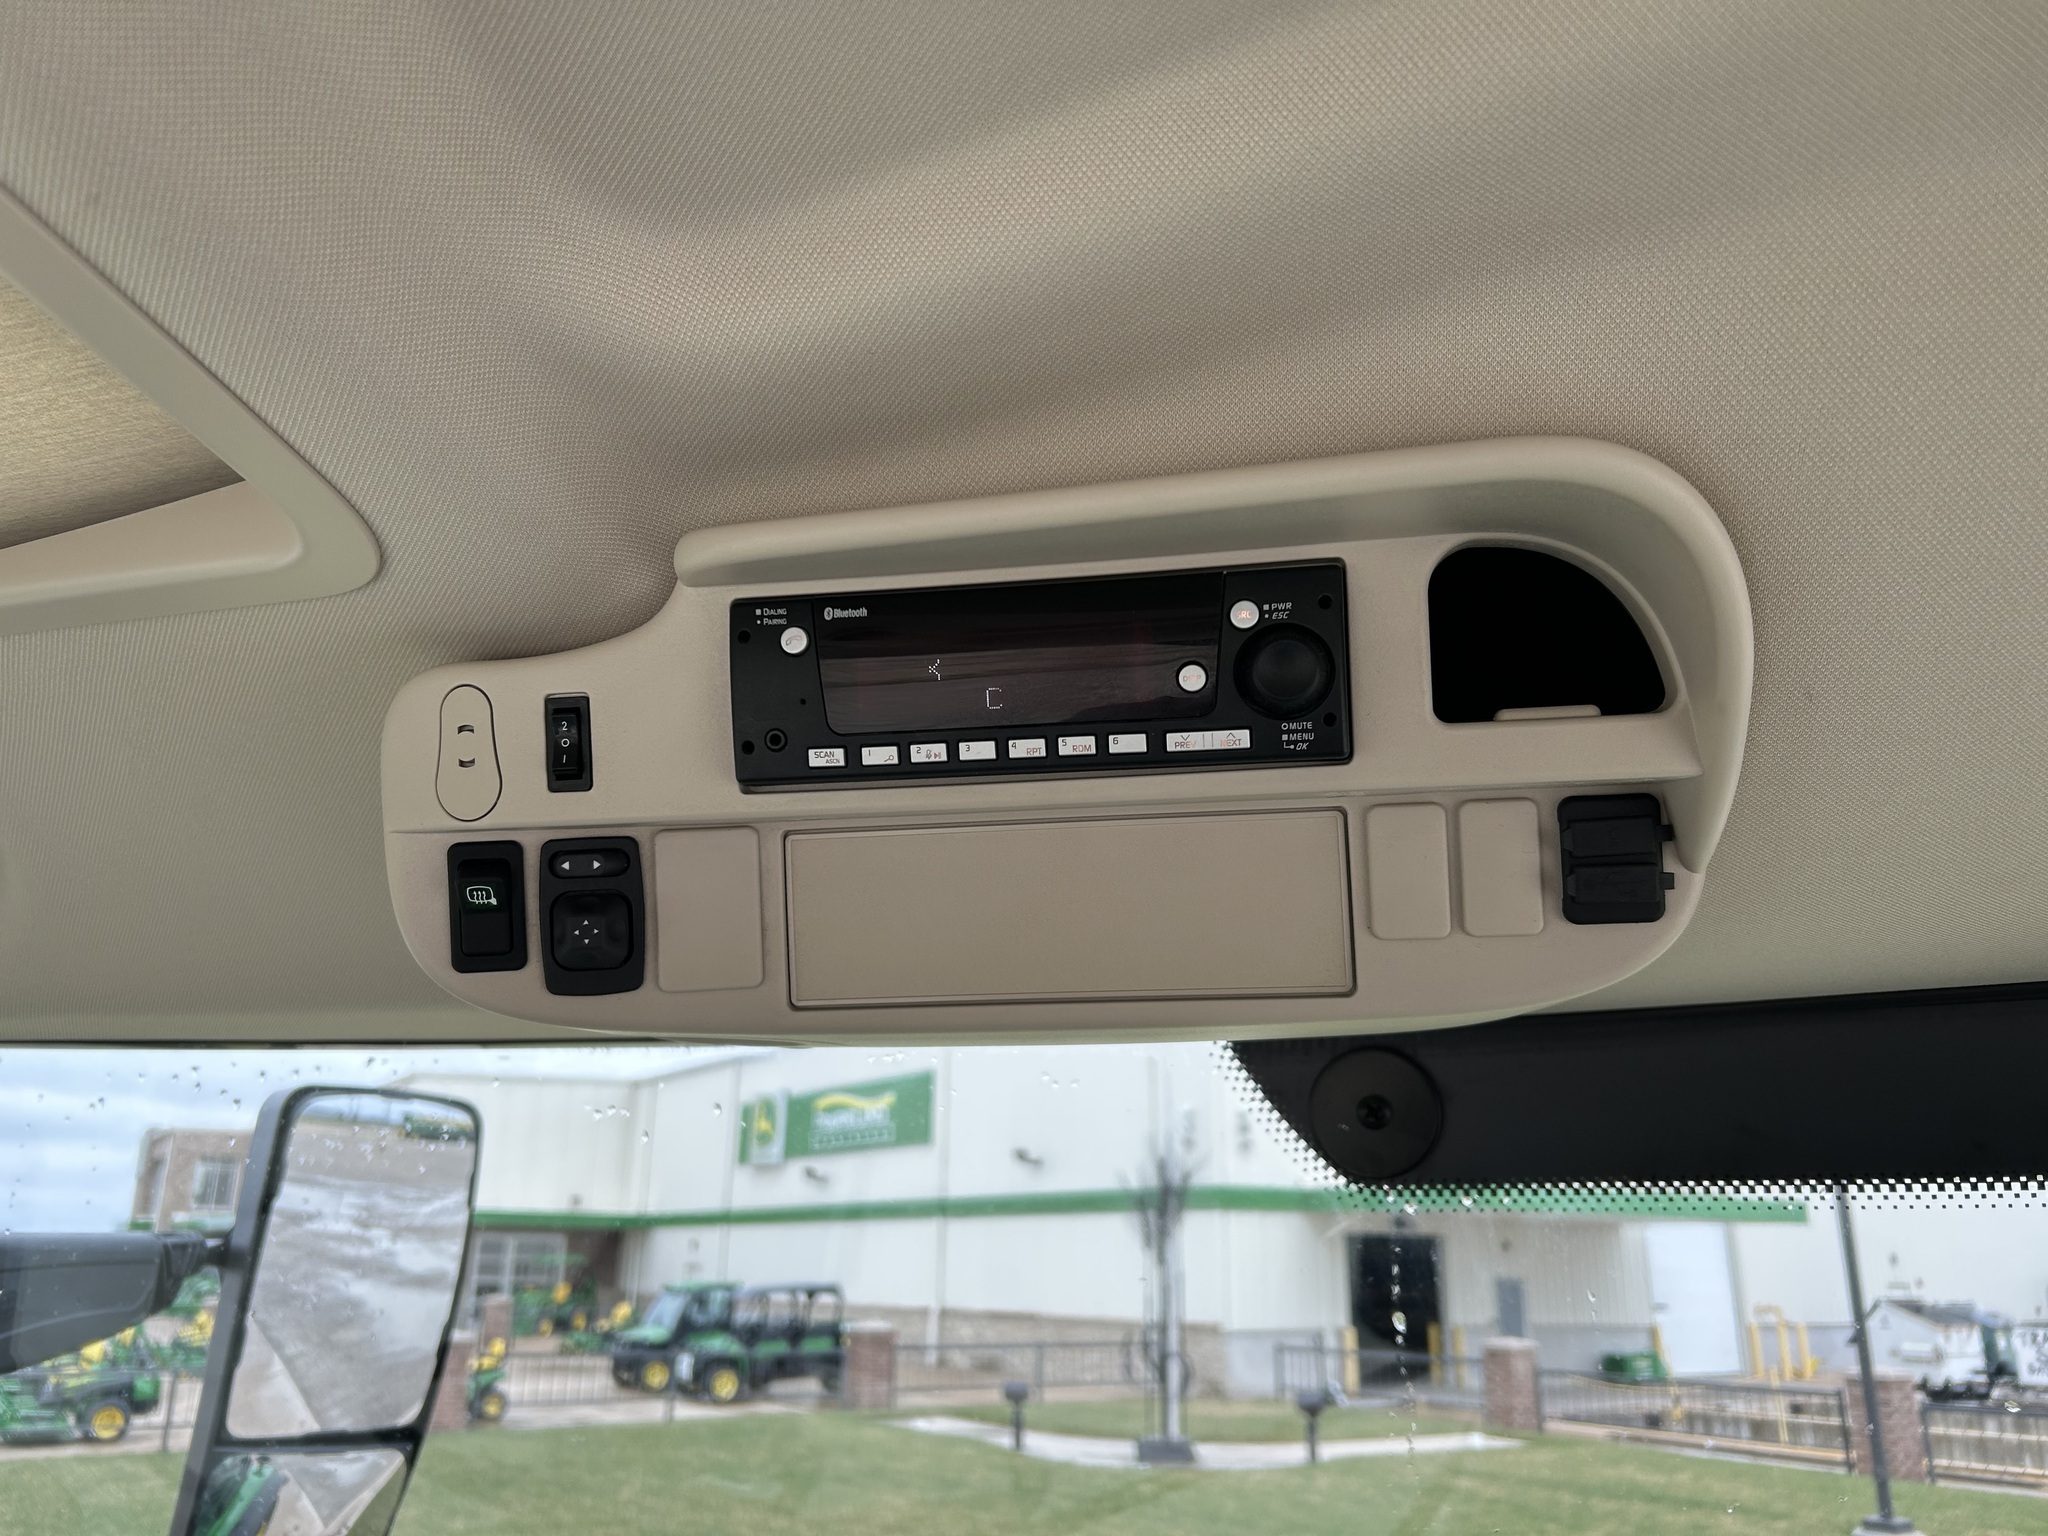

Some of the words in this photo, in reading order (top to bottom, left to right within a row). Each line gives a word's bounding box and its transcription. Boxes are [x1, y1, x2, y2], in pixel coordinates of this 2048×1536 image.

[1271, 602, 1292, 611] PWR
[833, 607, 868, 618] Bluetooth
[1271, 611, 1290, 619] ESC
[561, 721, 568, 731] 2
[1289, 721, 1313, 730] MUTE
[1289, 732, 1315, 741] MENU
[1061, 739, 1067, 747] 5
[1112, 737, 1119, 745] 6
[1174, 741, 1197, 749] PREV
[1220, 738, 1242, 747] NEXT
[916, 746, 922, 754] 2
[965, 744, 971, 752] 3
[1011, 742, 1017, 750] 4
[1295, 742, 1310, 751] OK
[814, 751, 835, 759] SCAN
[1026, 747, 1042, 756] RPT
